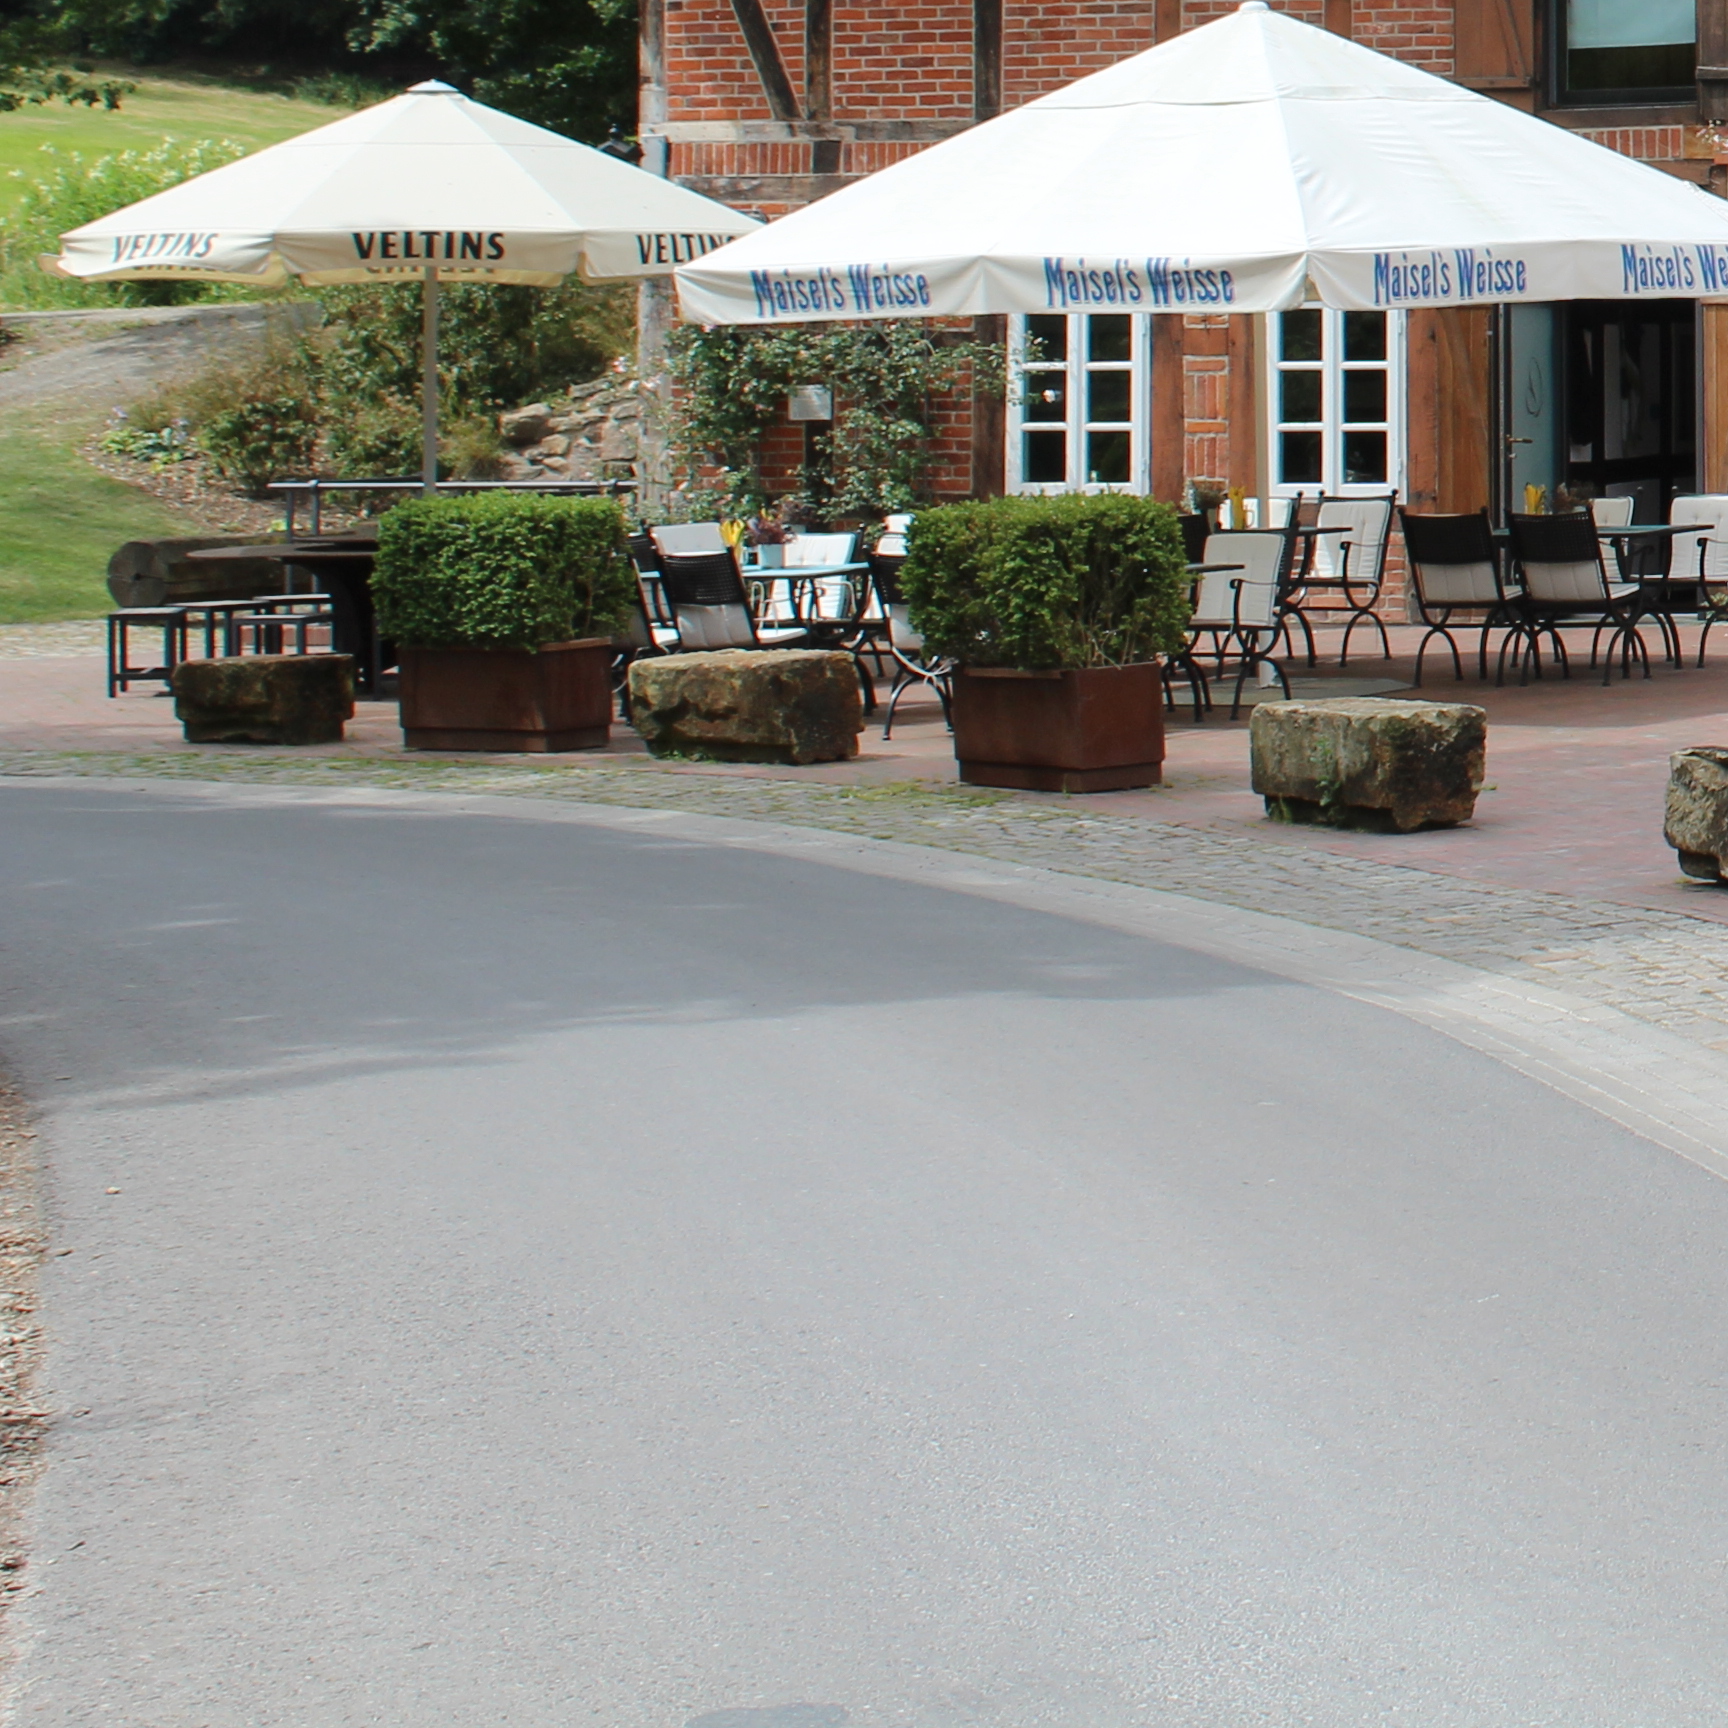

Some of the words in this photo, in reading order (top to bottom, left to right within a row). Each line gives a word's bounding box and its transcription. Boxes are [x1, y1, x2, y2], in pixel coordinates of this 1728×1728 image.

[113, 233, 218, 262] VELTINS
[352, 231, 505, 260] VELTINS
[1620, 243, 1695, 293] Maisel's
[750, 269, 846, 318] Maisel's
[847, 262, 933, 313] Weisse
[1043, 256, 1142, 308] Maisel's
[1144, 256, 1236, 308] Weisse
[1374, 251, 1450, 306] Maisel's
[1455, 247, 1527, 300] Weisse
